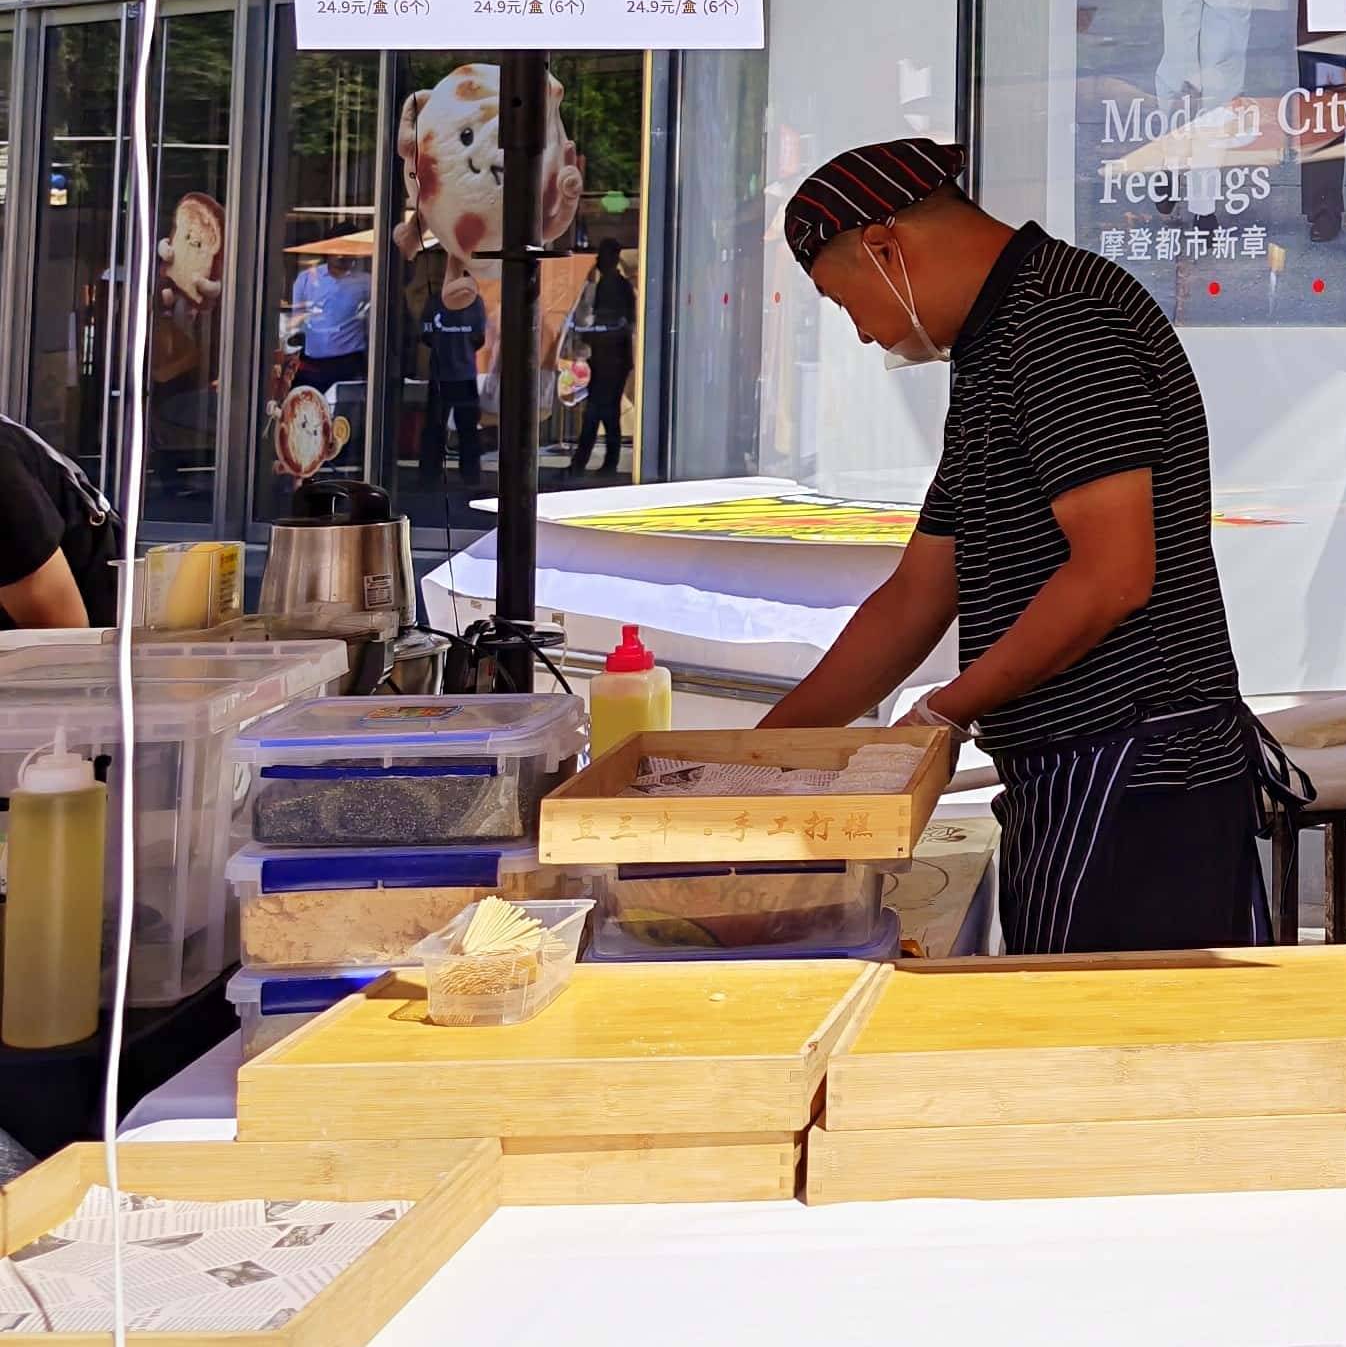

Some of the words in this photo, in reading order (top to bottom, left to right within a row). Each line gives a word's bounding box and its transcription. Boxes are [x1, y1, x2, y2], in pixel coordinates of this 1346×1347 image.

[1102, 94, 1262, 143] Modn
[1099, 159, 1271, 215] Feelings
[1101, 225, 1268, 261] 摩登都市新章
